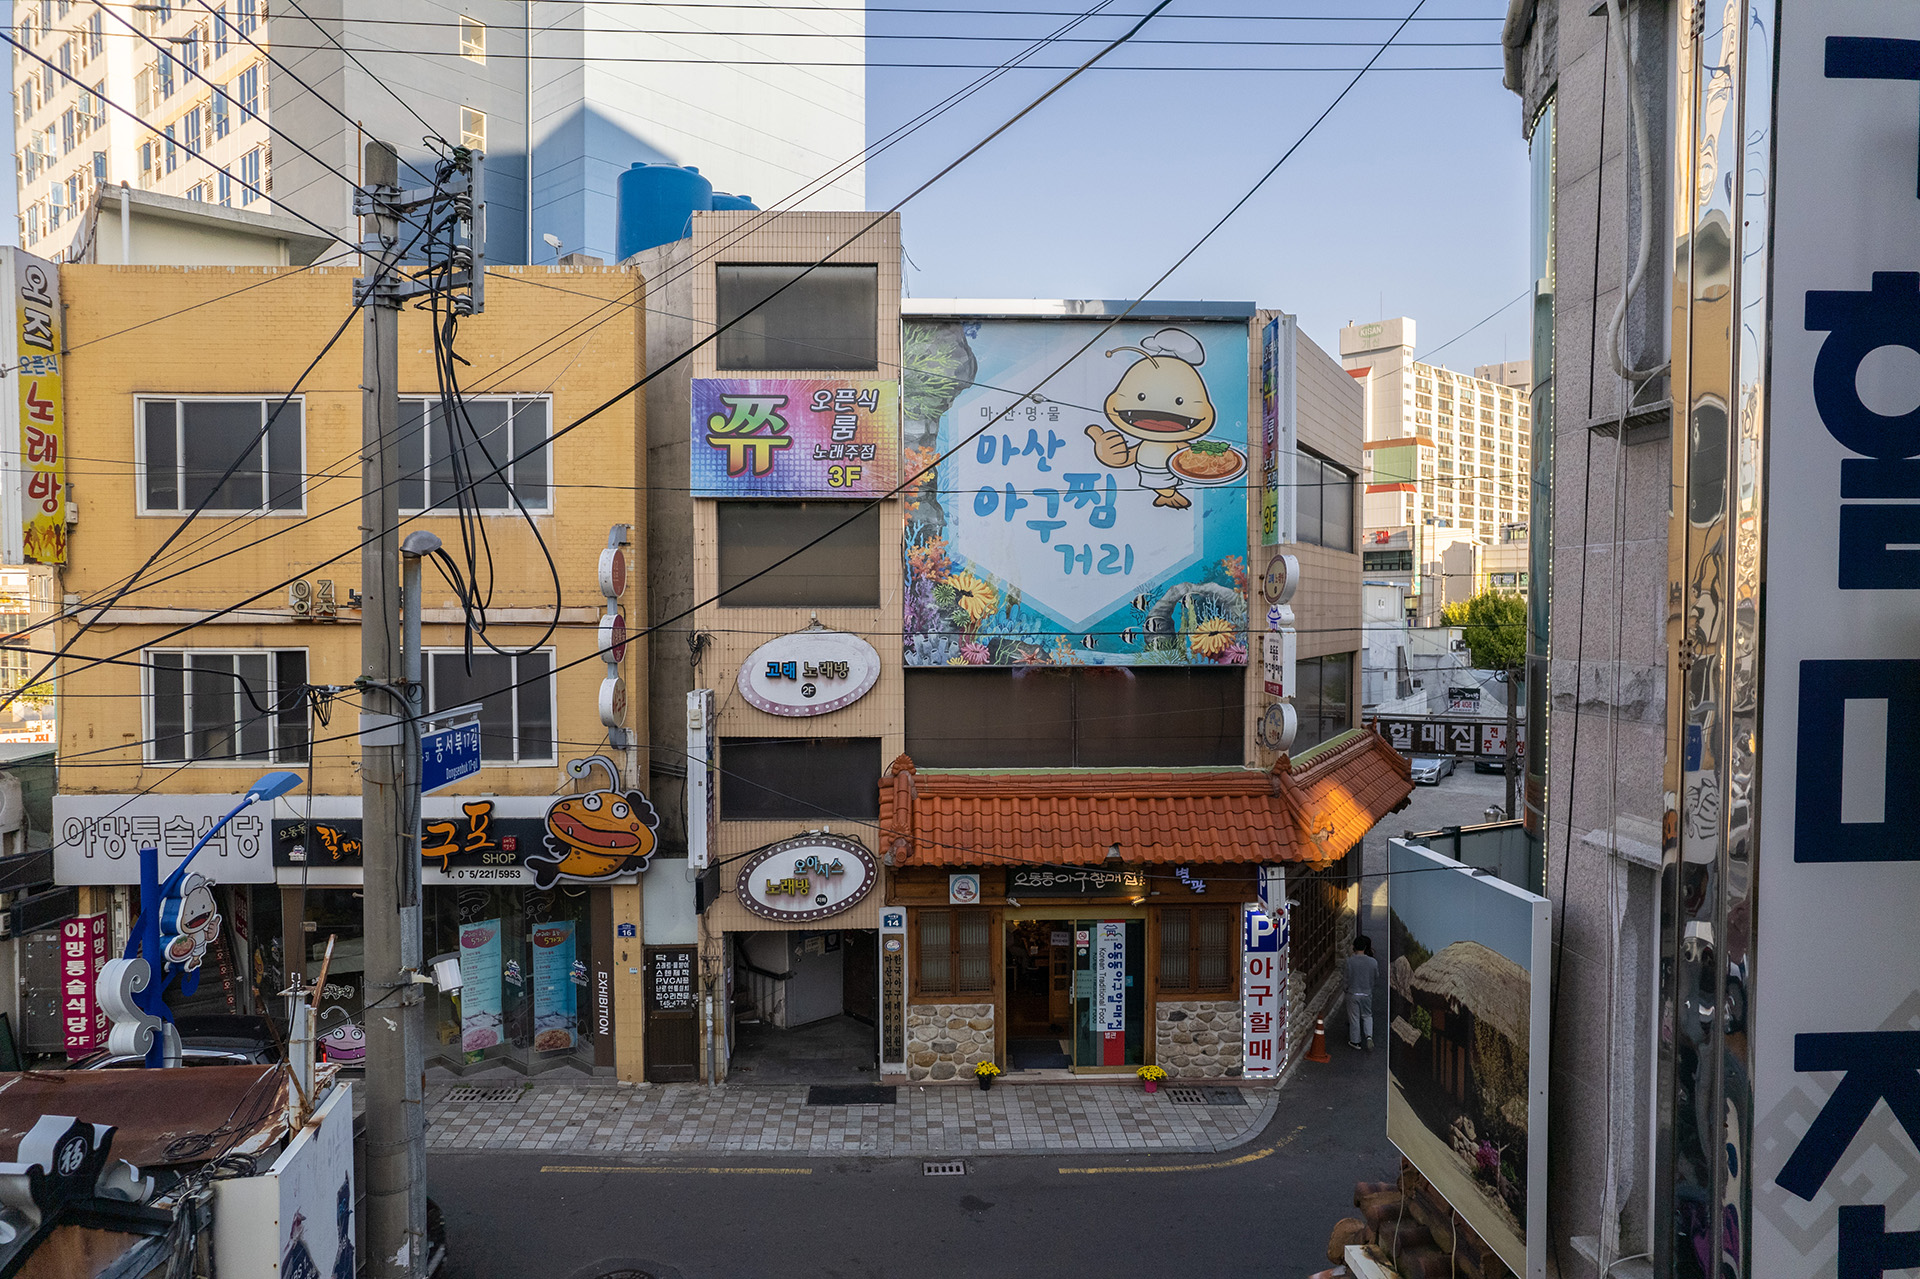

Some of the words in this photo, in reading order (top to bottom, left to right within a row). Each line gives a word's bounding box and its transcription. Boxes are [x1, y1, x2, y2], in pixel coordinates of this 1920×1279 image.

[1360, 326, 1382, 337] KISAN
[810, 388, 880, 412] 오픈식
[831, 413, 858, 442] 룸
[26, 381, 62, 513] 노래방
[813, 444, 876, 461] 노래주점
[976, 428, 1066, 472] 마산
[828, 465, 862, 488] 3F
[973, 473, 1118, 543] 아구찜
[1264, 504, 1277, 534] 3F
[1054, 543, 1134, 576] 거리
[766, 661, 797, 680] 고래
[802, 661, 849, 679] 노래방
[803, 686, 815, 695] 2F
[435, 727, 478, 763] 동서북17길
[63, 815, 263, 859] 야망통술식당
[482, 854, 516, 864] SHOP
[794, 856, 844, 878] 오아시스
[458, 870, 521, 878] 05/221/5953
[765, 878, 810, 896] 노래방
[1251, 914, 1275, 948] P
[64, 922, 88, 1033] 야망통술식당
[598, 971, 608, 1036] EXHIBITION
[1248, 957, 1273, 1061] 아구할매
[67, 1036, 90, 1046] 2F
